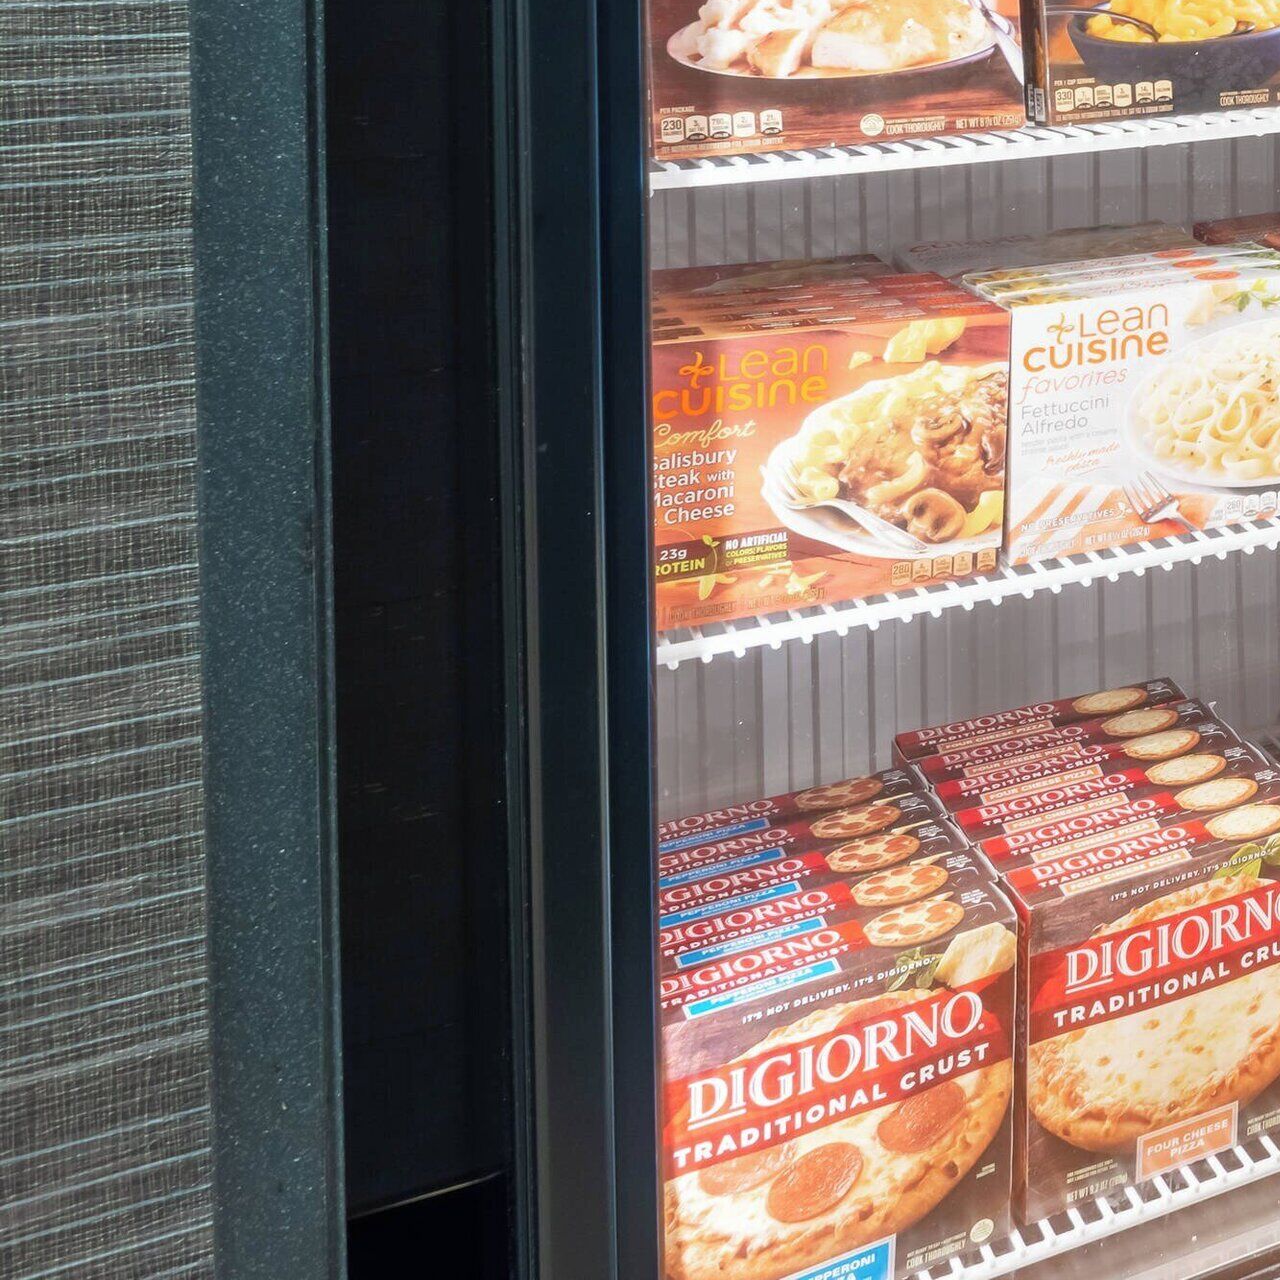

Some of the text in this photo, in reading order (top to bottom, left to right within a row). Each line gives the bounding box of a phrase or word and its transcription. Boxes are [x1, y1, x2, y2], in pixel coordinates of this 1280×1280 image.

[1220, 92, 1270, 107] COOK THOROUGHLY
[662, 120, 682, 131] 230
[886, 122, 945, 136] COOK THOROUGHLY
[1080, 303, 1168, 338] Lean
[720, 343, 829, 380] Lean
[1016, 367, 1128, 405] favorites
[1021, 394, 1110, 420] Fettuccini
[653, 419, 756, 450] Comfort
[1021, 415, 1088, 437] Alfredo
[706, 468, 735, 482] with
[664, 502, 735, 526] Cheese
[725, 531, 788, 550] NO ARTIFICIAL
[660, 547, 687, 562] 23g
[733, 551, 788, 565] PRESERVATIVES
[655, 557, 706, 577] ROTEIN
[1110, 891, 1128, 902] IT'S
[1131, 886, 1151, 898] NOT
[1203, 863, 1220, 875] IT'S
[742, 1012, 763, 1024] IT'S
[766, 1001, 792, 1017] NOT
[854, 975, 874, 988] IT'S
[1054, 963, 1231, 1029] TRADITIONAL
[674, 1042, 992, 1168] TRADITIONAL CRUST
[1146, 1119, 1229, 1157] FOUR CHEESE
[1246, 1125, 1261, 1136] COOK
[1170, 1139, 1206, 1158] PIZZA
[906, 1257, 924, 1271] COOK
[924, 1240, 968, 1266] THOROUGHLY
